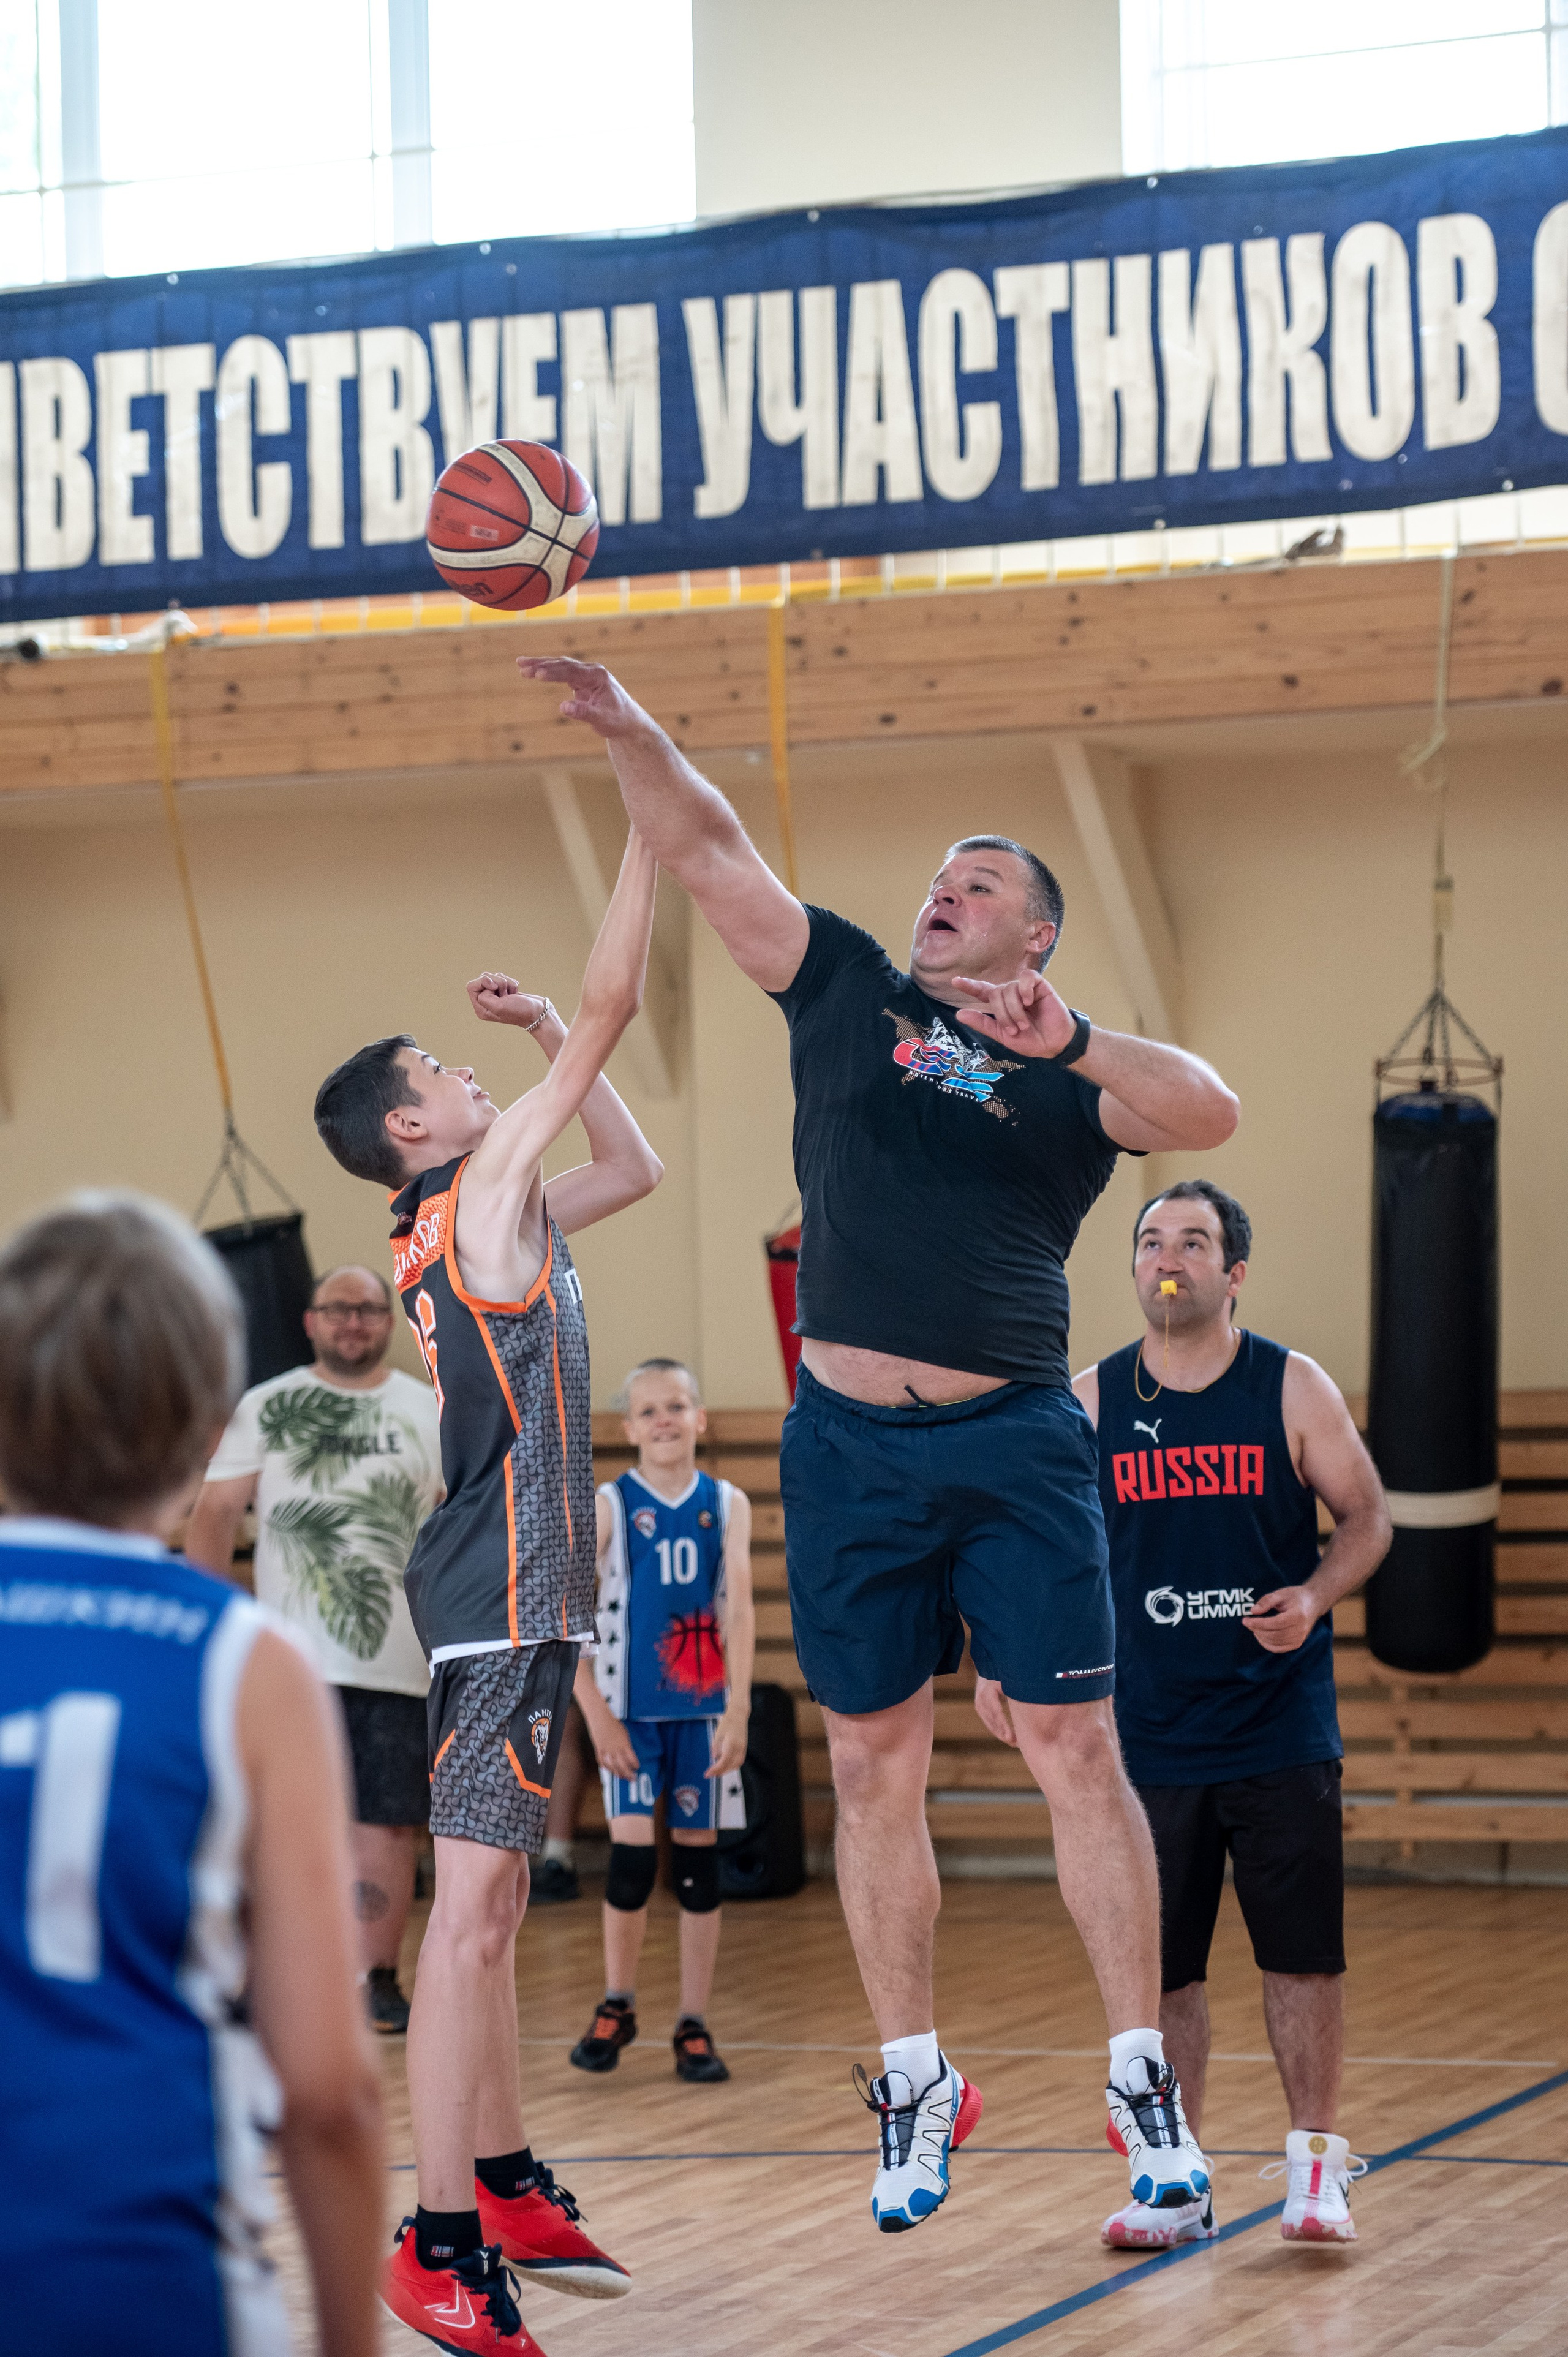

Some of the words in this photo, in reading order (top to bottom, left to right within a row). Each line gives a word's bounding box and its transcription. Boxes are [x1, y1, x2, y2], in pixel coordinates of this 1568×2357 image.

[0, 302, 663, 575] ВЕТСТВУЕМ
[682, 211, 1502, 519] УЧАСТНИКОВ
[1112, 1444, 1264, 1503] RUSSIA
[654, 1537, 698, 1586] 10
[1187, 1588, 1254, 1605] УГМК
[1188, 1602, 1256, 1619] UMMC
